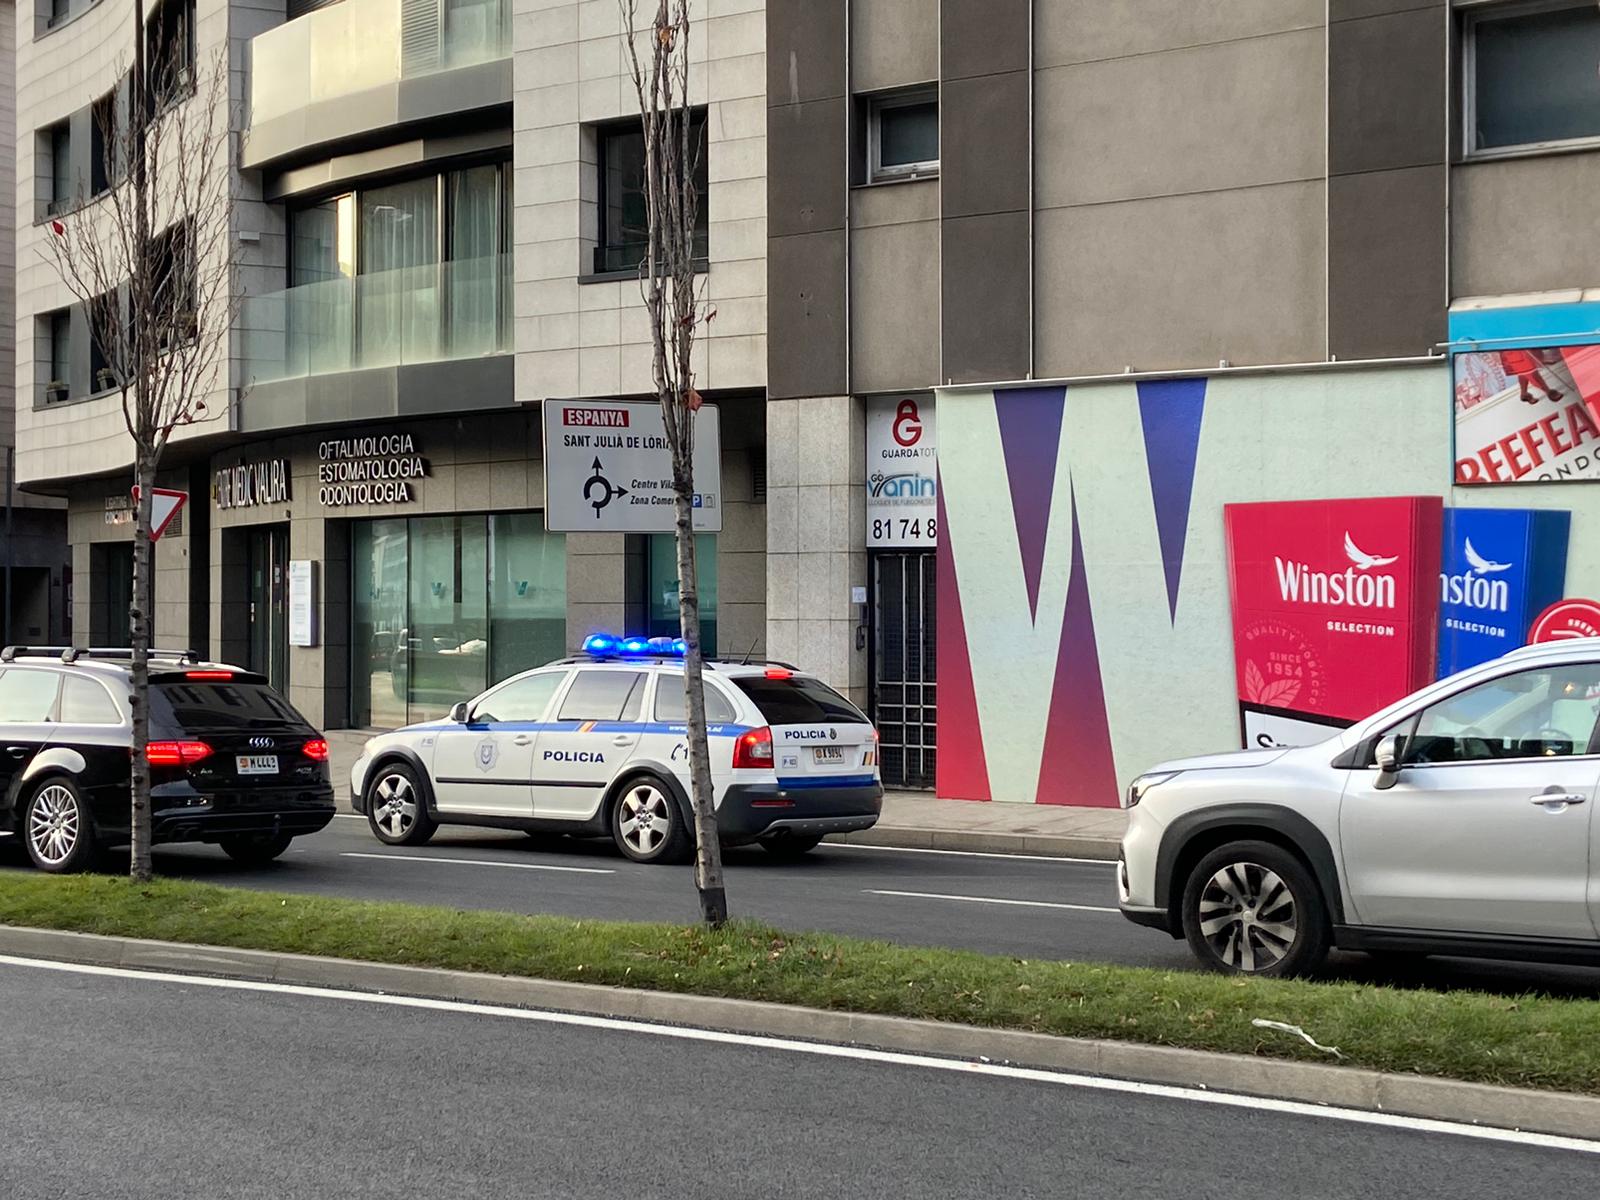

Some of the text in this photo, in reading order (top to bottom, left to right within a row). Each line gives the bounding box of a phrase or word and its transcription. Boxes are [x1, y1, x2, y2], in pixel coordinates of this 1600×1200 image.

[567, 409, 625, 426] ESPANYA
[319, 434, 414, 460] OFTALMOLOGIA
[563, 434, 591, 447] SANT
[593, 432, 624, 448] JULIÀ
[626, 436, 640, 449] DE
[319, 457, 425, 483] ESTOMATOLOGIA
[254, 459, 287, 504] VALIRA
[631, 478, 658, 489] Centre
[319, 482, 409, 506] ODONTOLOGIA
[630, 495, 649, 505] Zona
[873, 518, 936, 539] 81 74 8
[1274, 556, 1395, 608] Winston
[1246, 625, 1296, 641] QUALITY
[1327, 620, 1395, 637] SELECTION
[1446, 618, 1506, 638] SELECTION
[1269, 651, 1302, 663] SINCE
[1266, 662, 1304, 678] 1954
[784, 729, 827, 740] POLICIA
[543, 750, 605, 763] POLICIA
